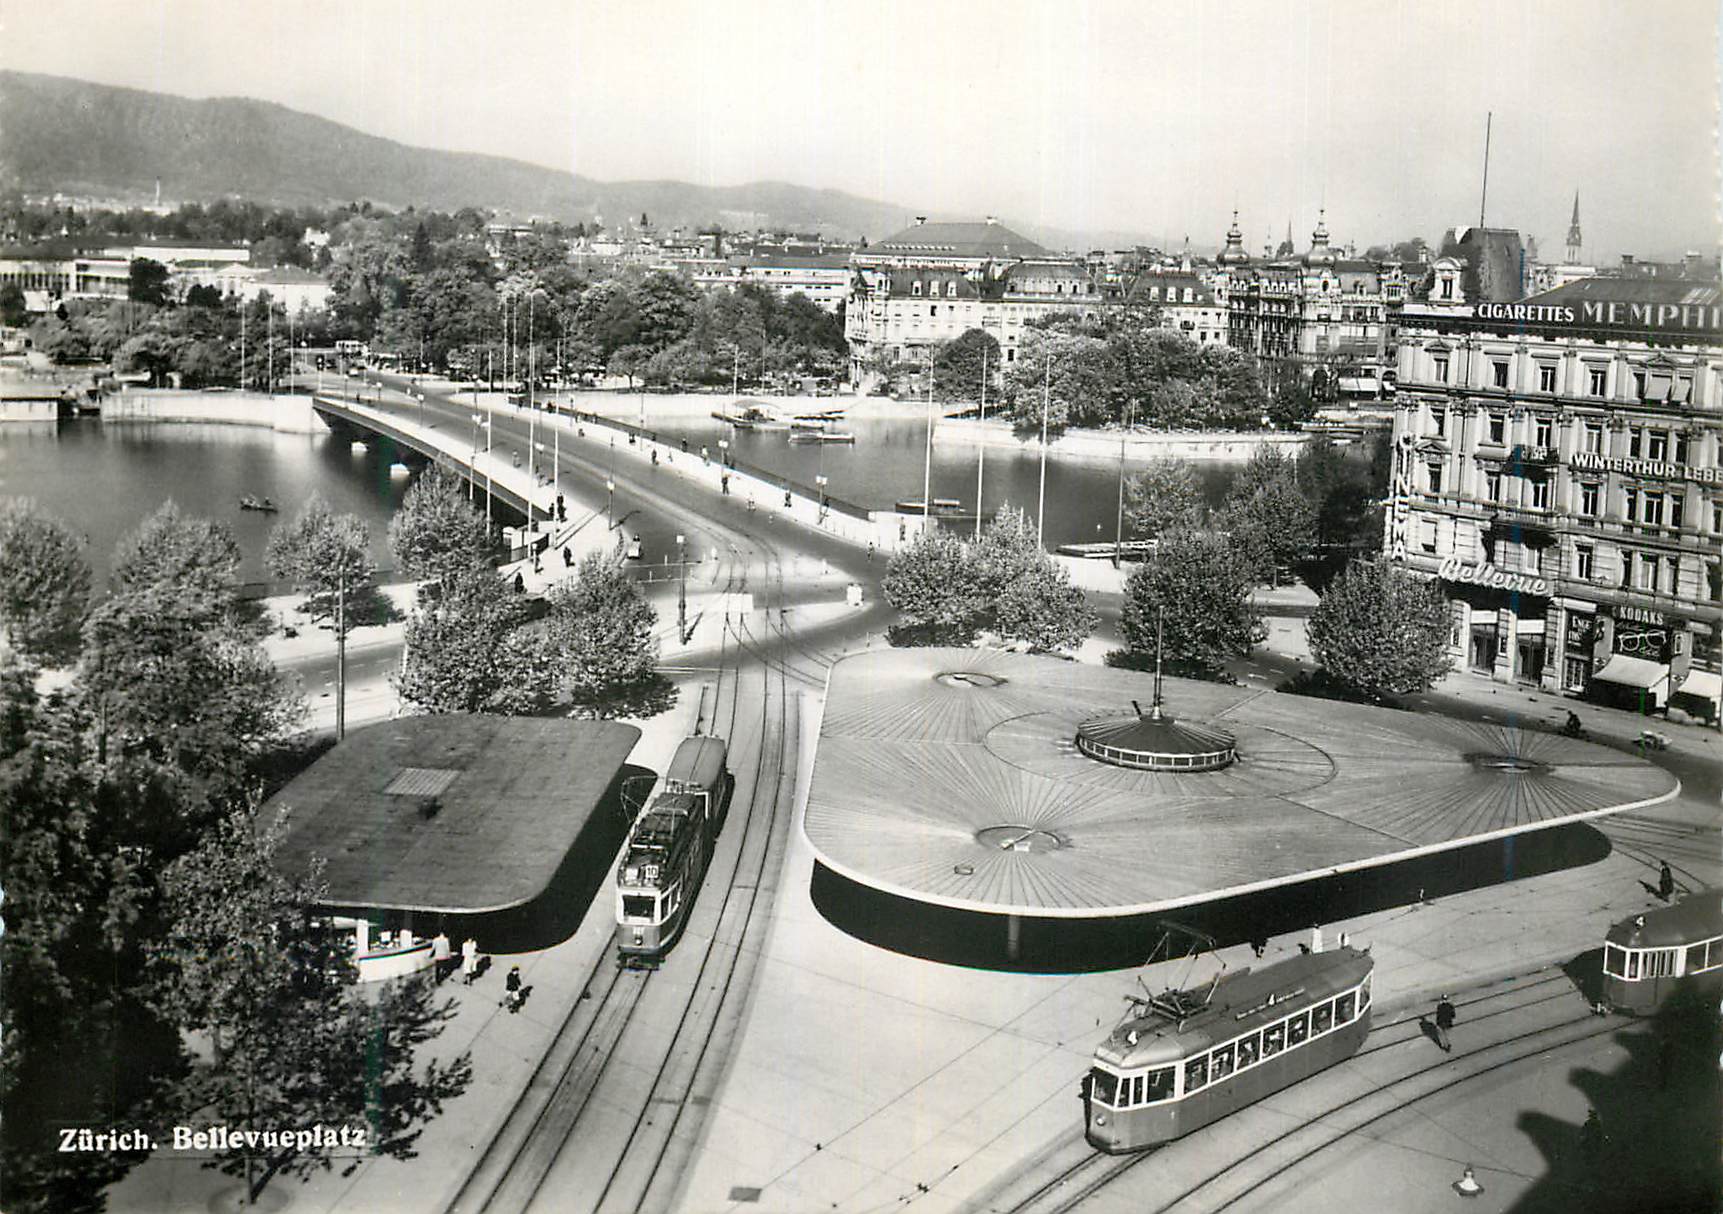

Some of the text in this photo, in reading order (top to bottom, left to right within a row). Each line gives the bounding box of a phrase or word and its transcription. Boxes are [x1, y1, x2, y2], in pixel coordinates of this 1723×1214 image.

[1477, 302, 1575, 323] CIGARETTES
[1573, 452, 1677, 479] WINTERTHUR
[1438, 556, 1551, 597] Bellevue
